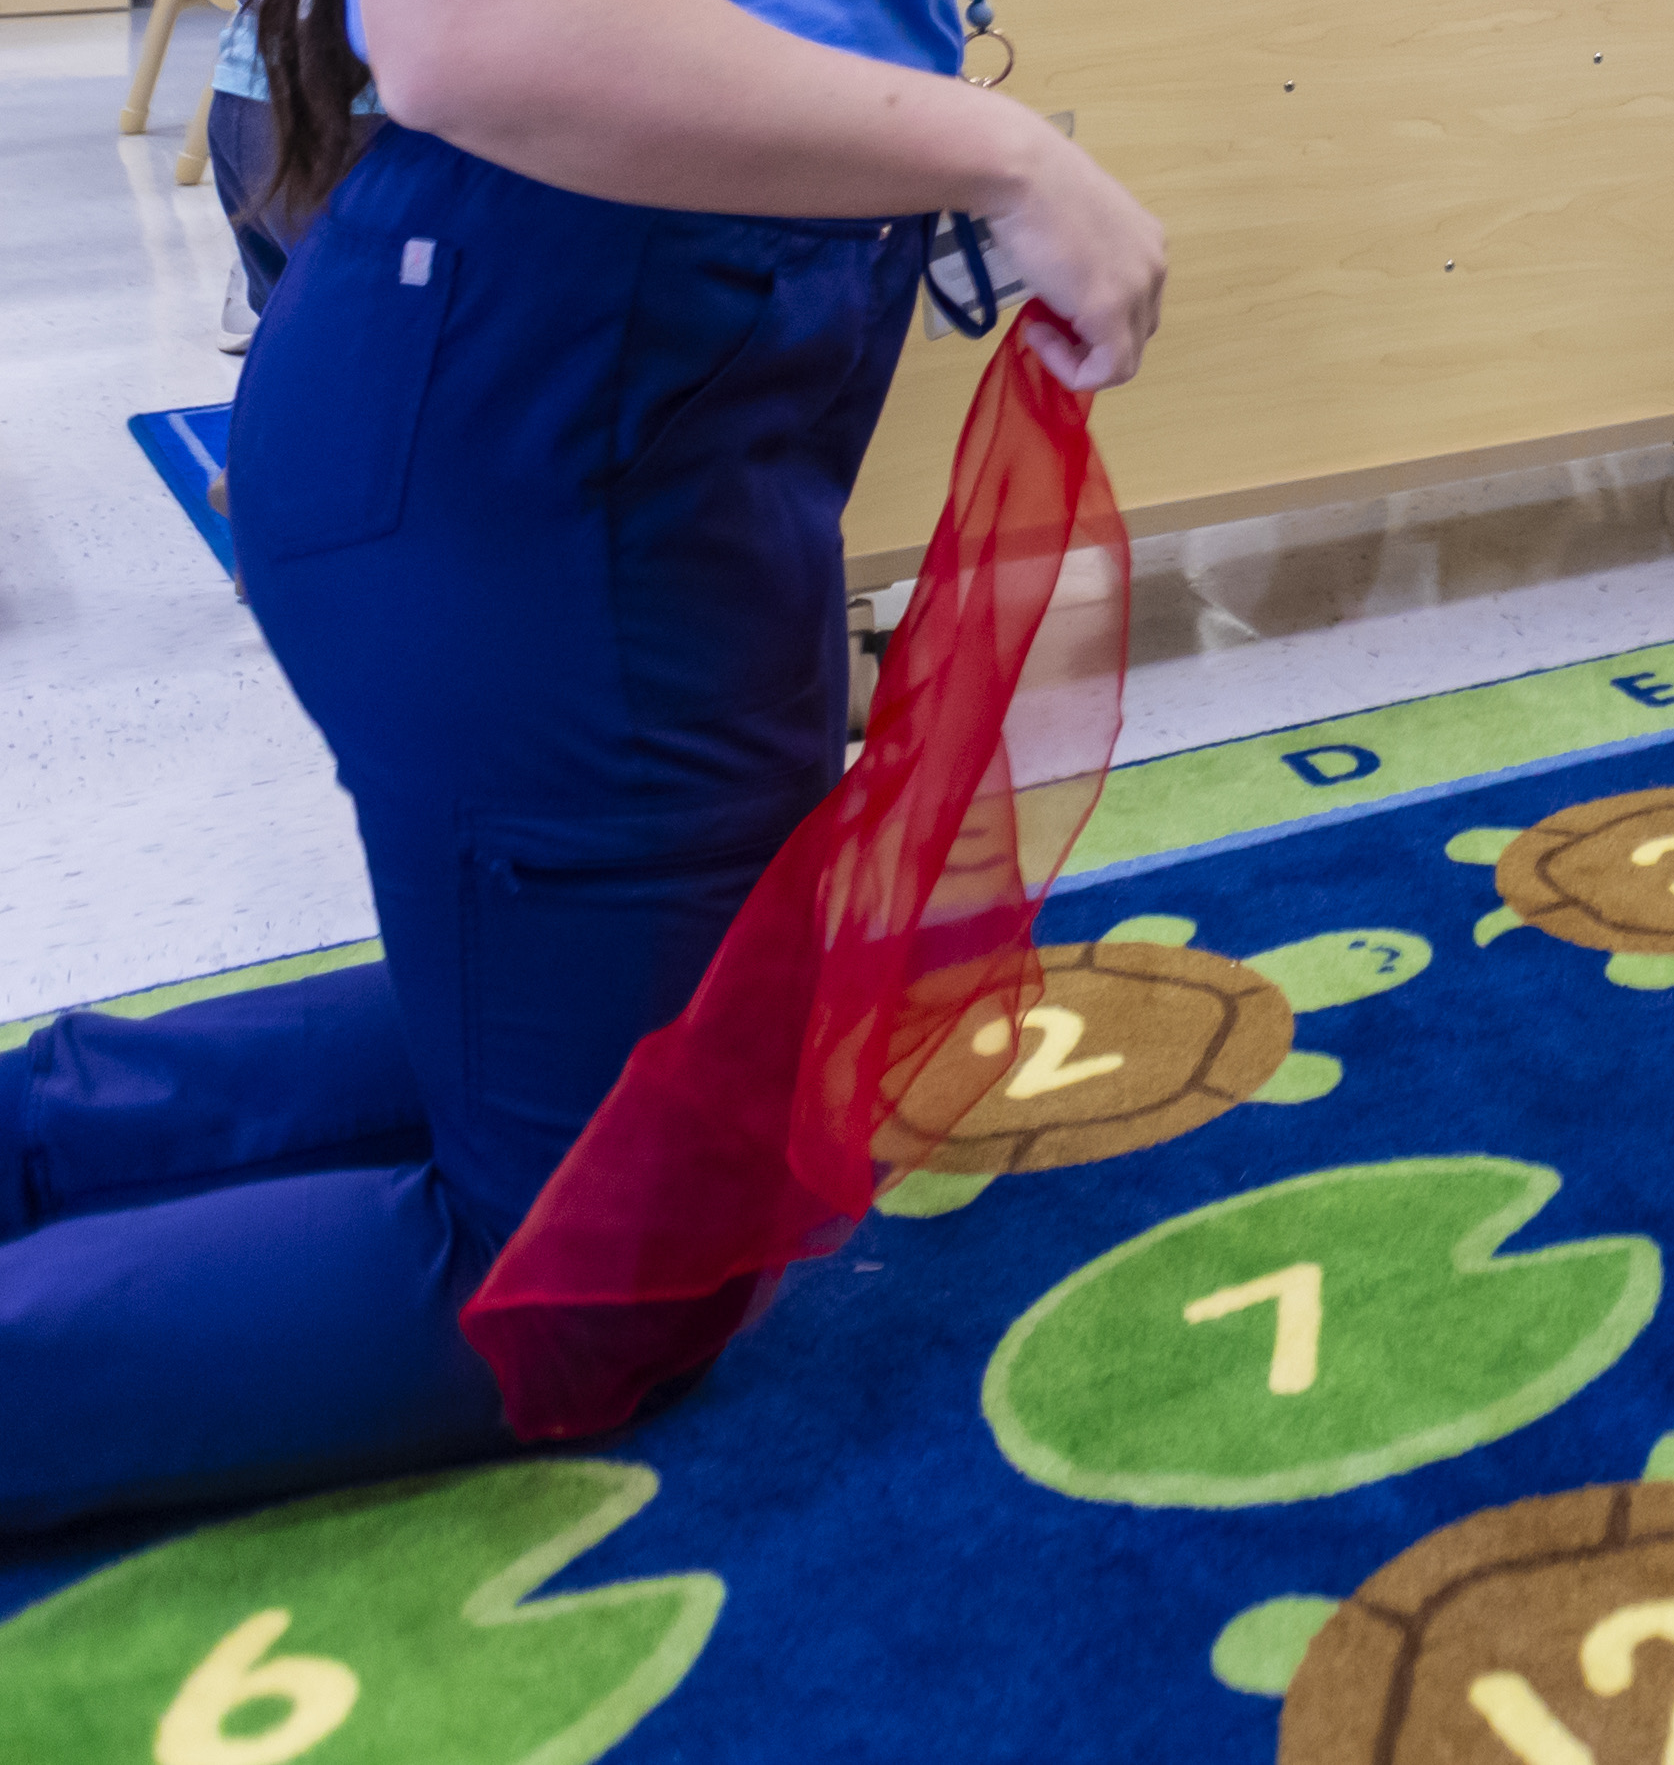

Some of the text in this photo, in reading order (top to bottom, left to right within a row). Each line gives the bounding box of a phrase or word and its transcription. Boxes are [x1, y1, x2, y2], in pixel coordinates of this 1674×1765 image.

[1281, 744, 1381, 786] D
[971, 1005, 1124, 1100] 2
[1183, 1261, 1323, 1395] 7
[152, 1608, 360, 1765] 6
